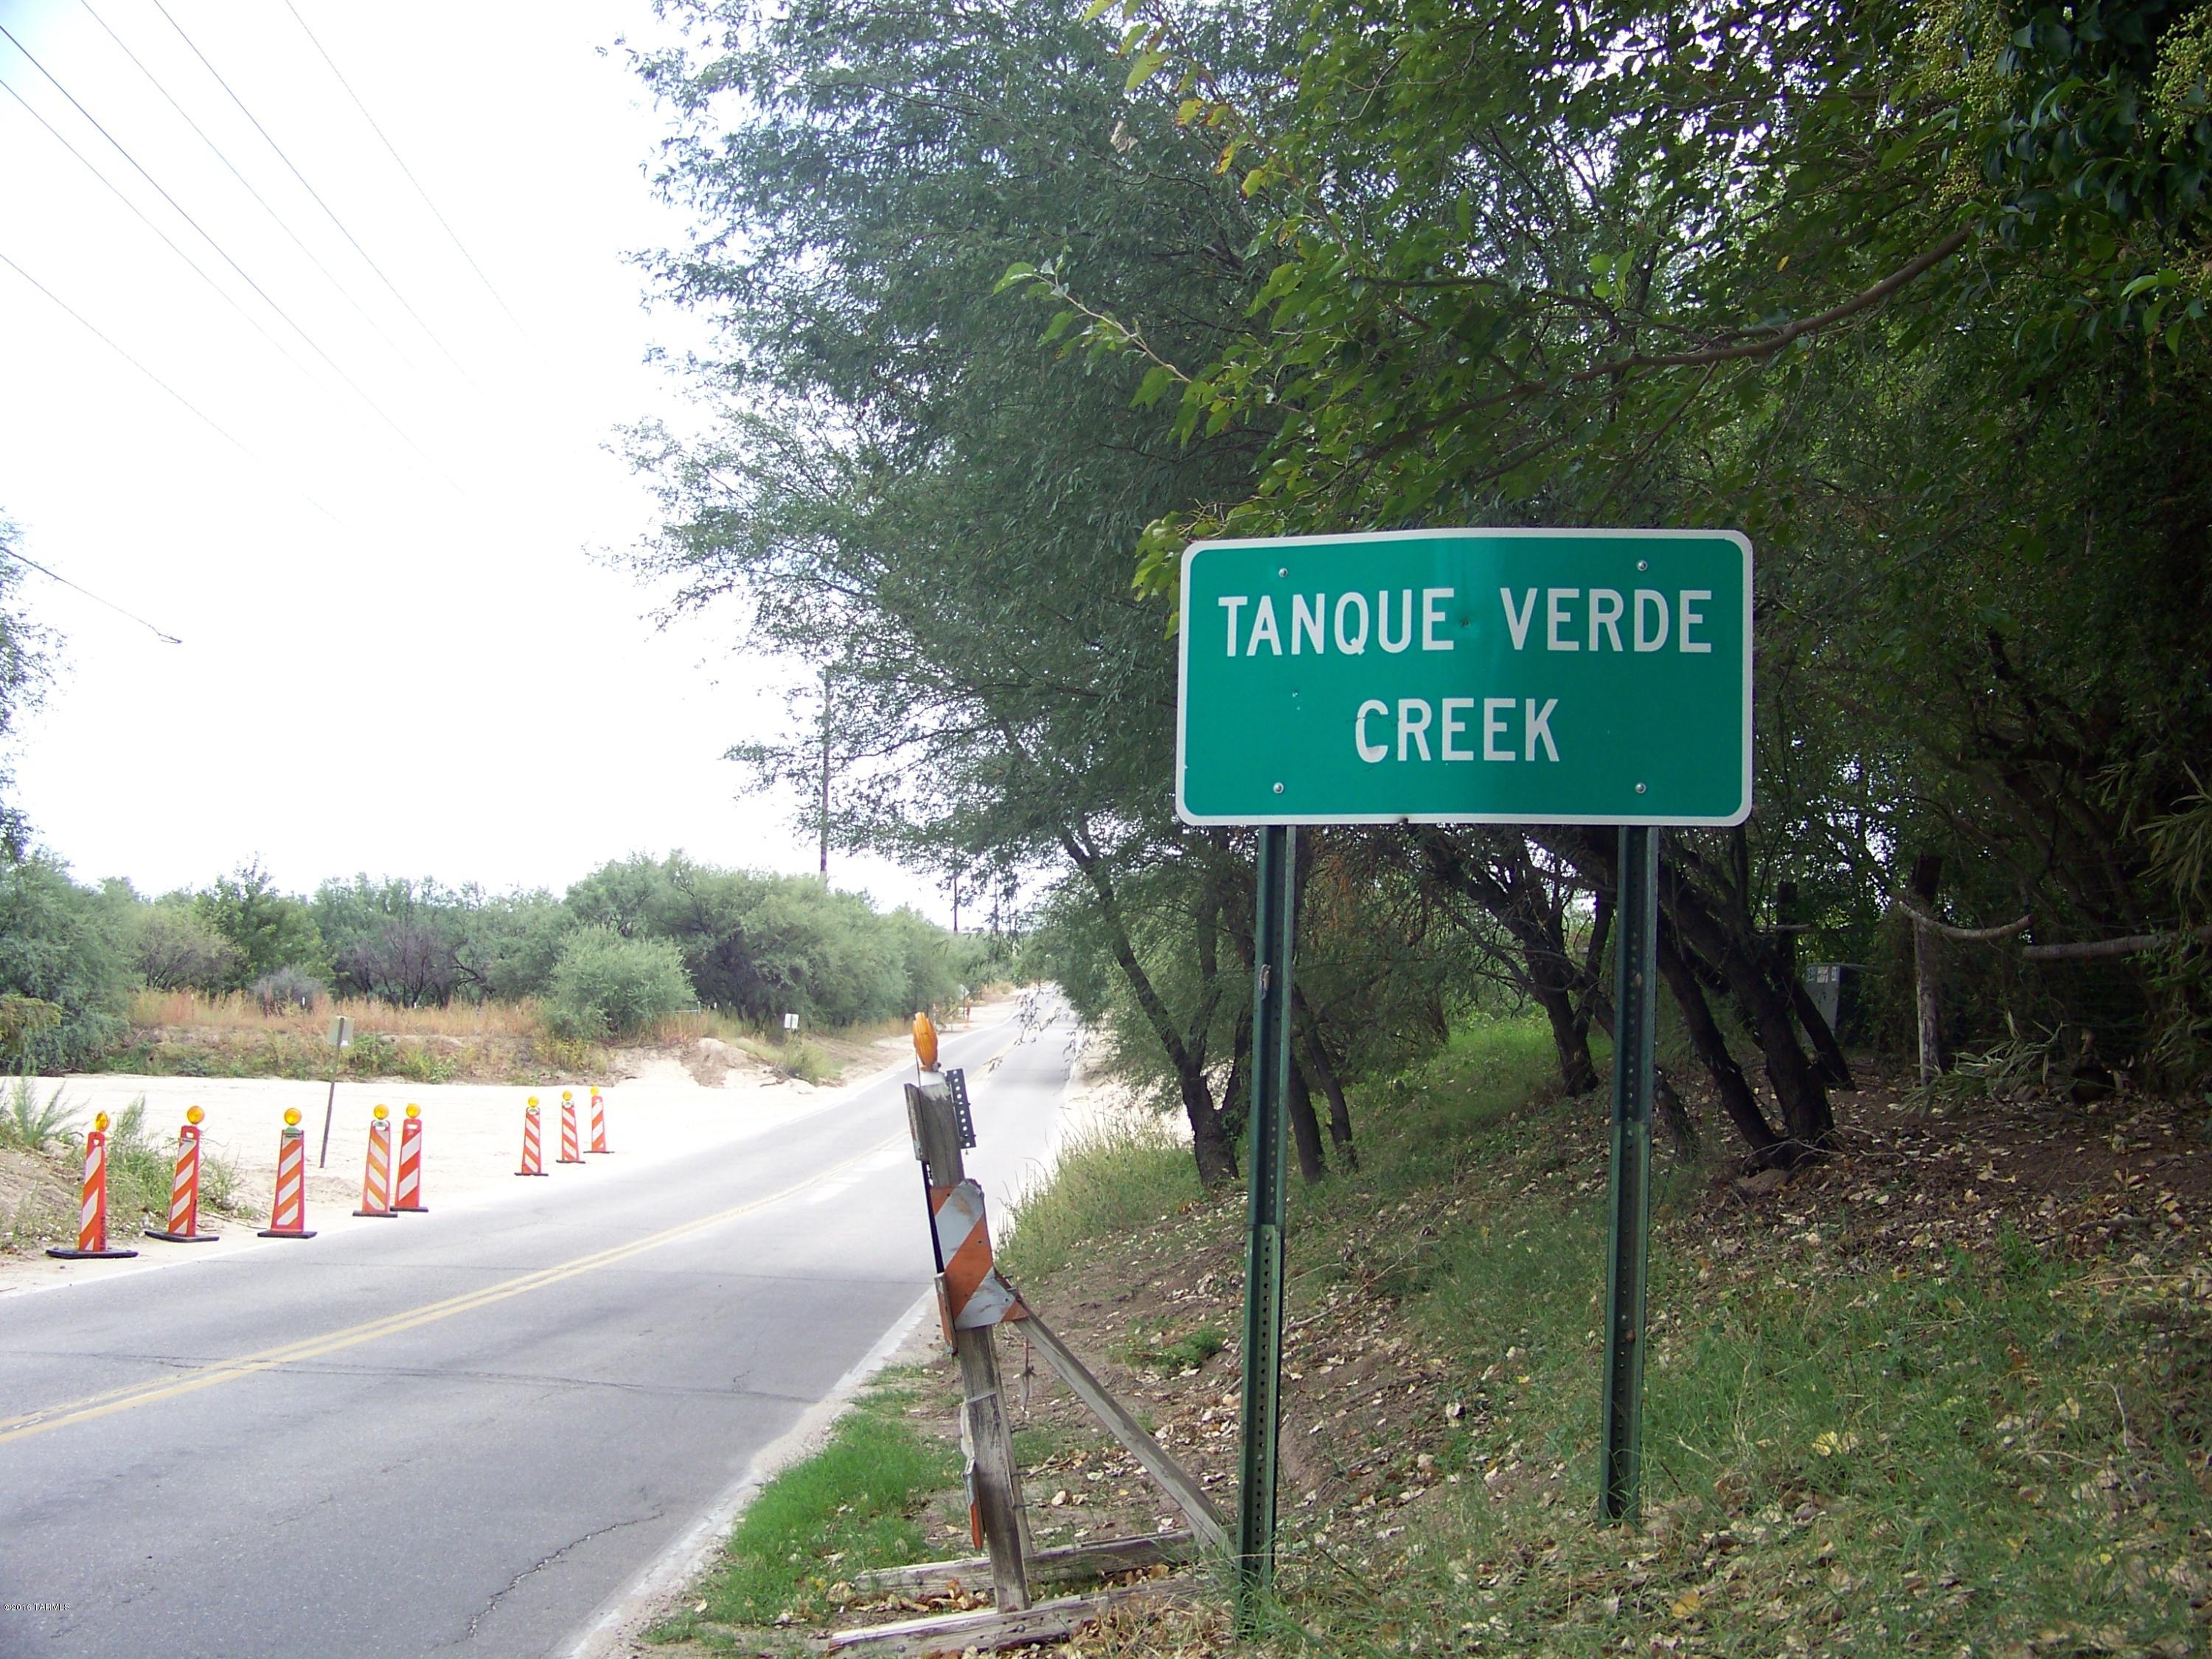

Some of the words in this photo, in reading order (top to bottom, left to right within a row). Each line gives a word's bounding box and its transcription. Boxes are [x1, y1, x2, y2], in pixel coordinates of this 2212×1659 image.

[1218, 588, 1455, 656] TANQUE
[1500, 588, 1712, 653] VERDE
[1355, 698, 1559, 763] CREEK
